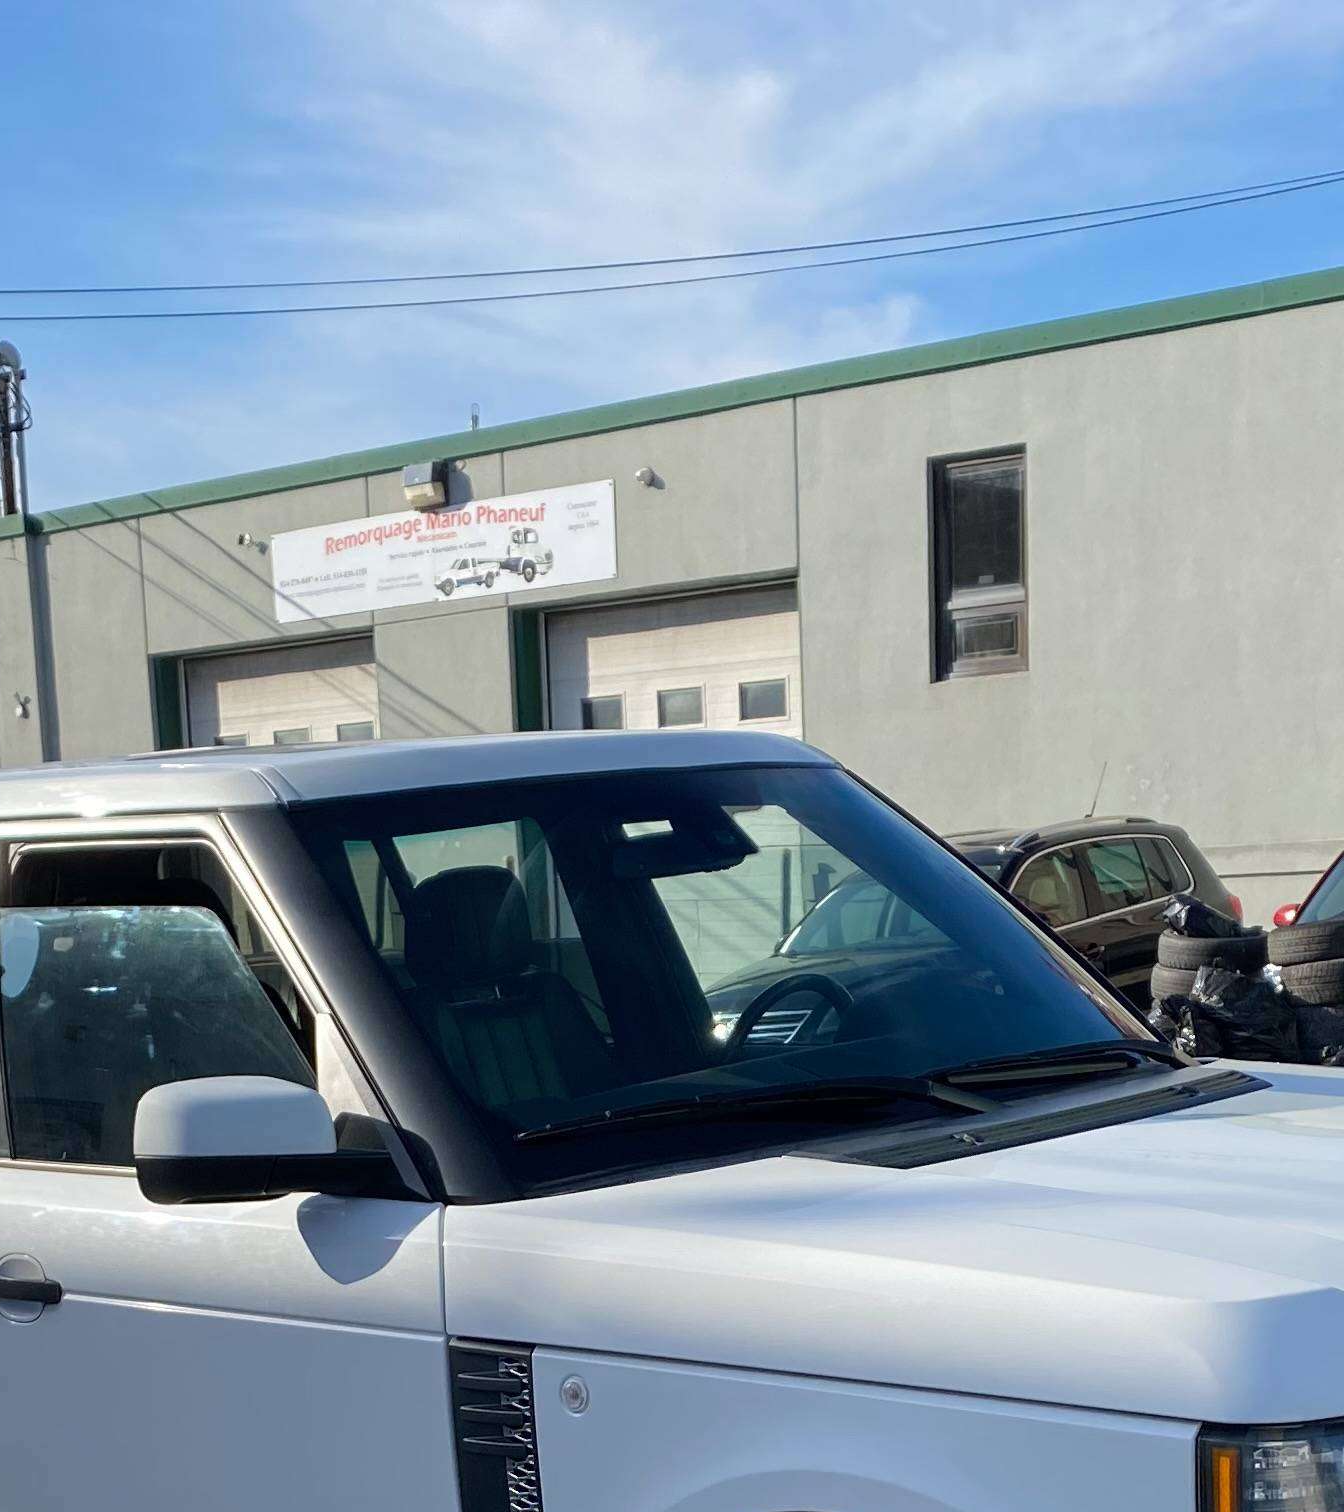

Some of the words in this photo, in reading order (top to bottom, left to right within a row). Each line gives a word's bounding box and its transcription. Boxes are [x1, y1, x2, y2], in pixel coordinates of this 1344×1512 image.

[324, 517, 423, 556] Remorquage
[426, 509, 472, 531] Mario
[476, 502, 546, 524] Phaneuf
